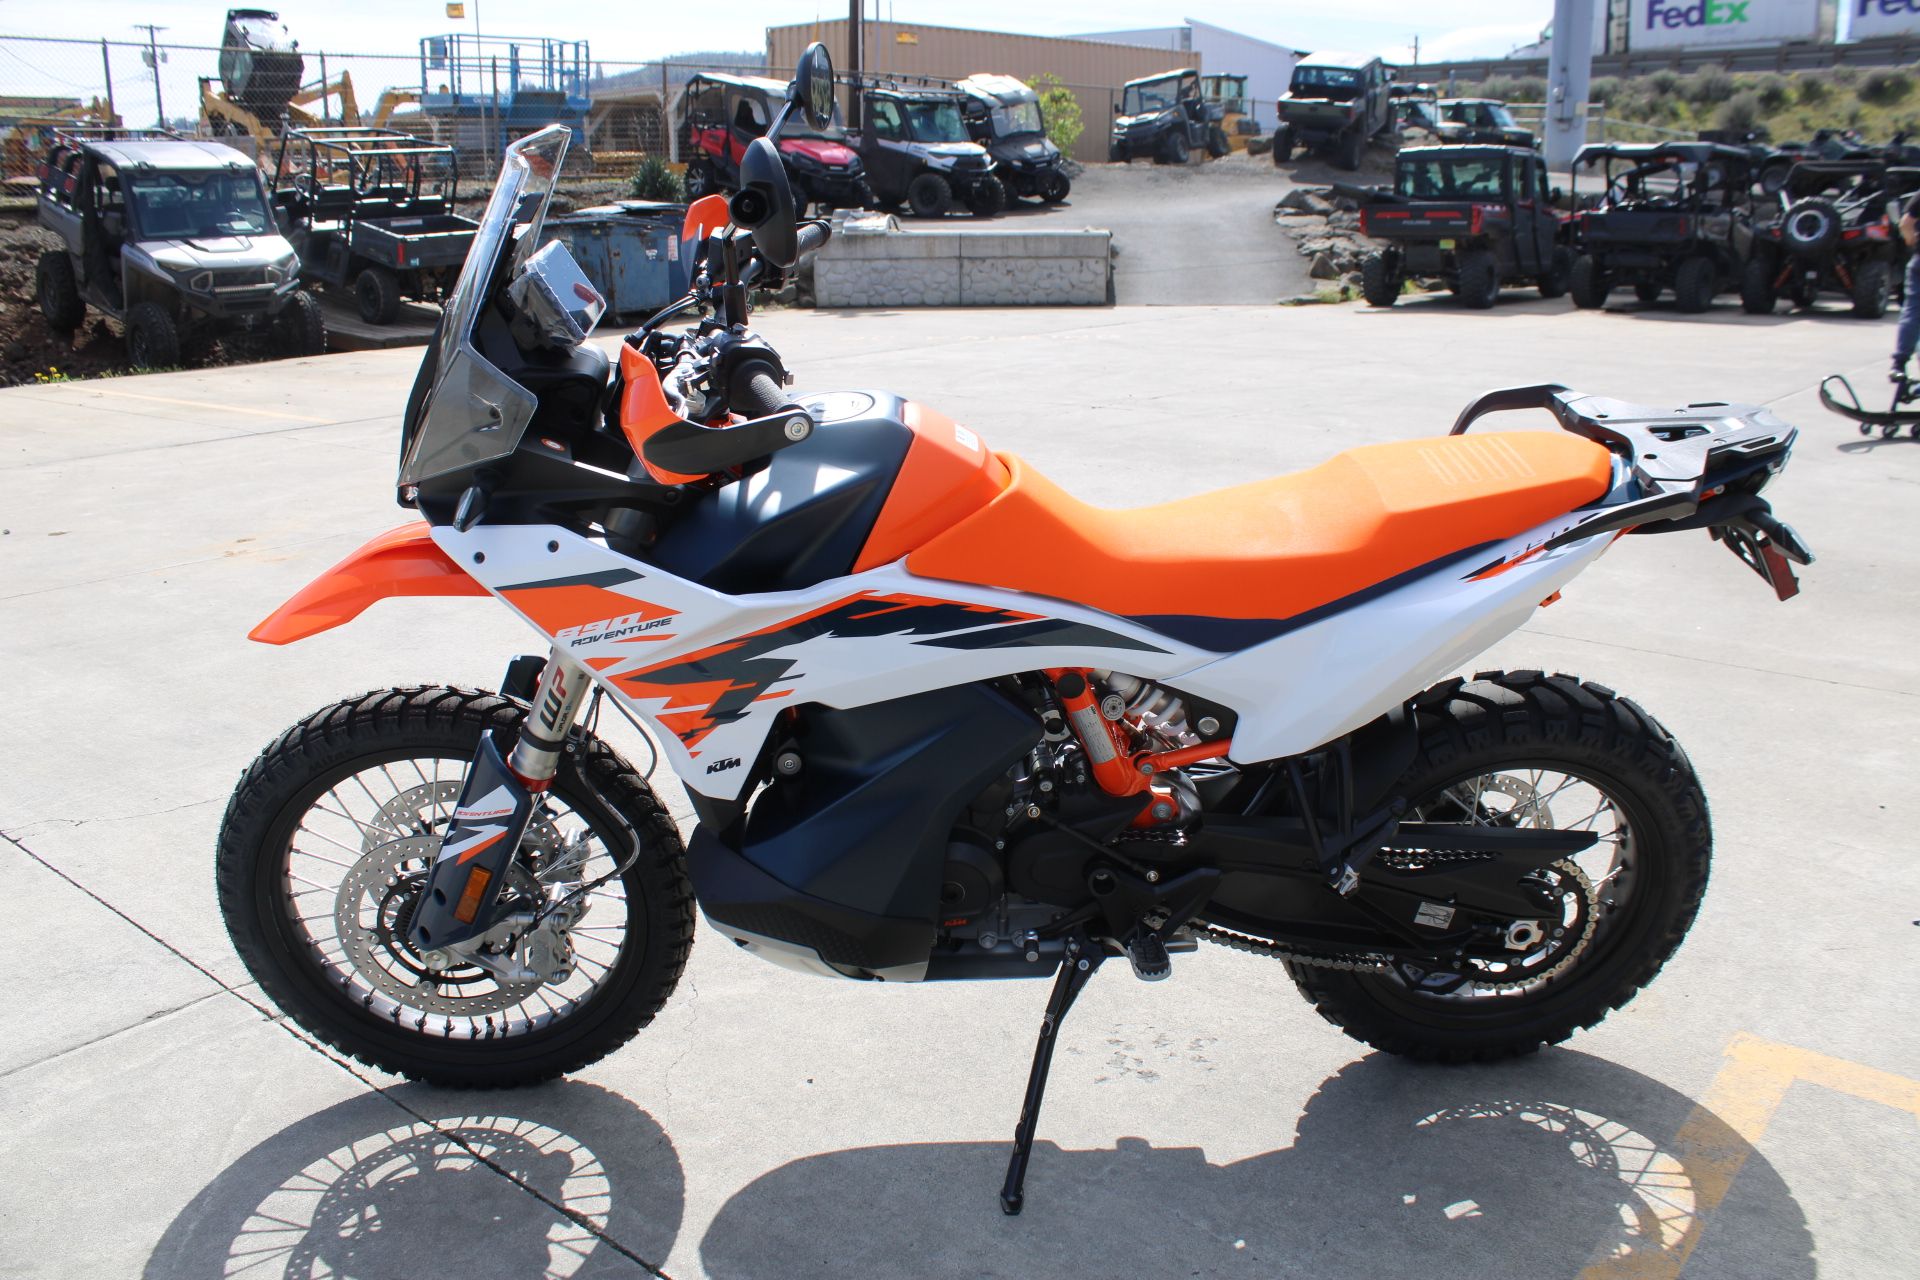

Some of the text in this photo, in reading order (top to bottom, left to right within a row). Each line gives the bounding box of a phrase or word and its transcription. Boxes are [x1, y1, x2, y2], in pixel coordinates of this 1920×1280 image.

[1646, 0, 1748, 30] FedEx
[555, 611, 644, 638] 890
[570, 617, 673, 648] ADVENTURE
[540, 665, 567, 732] WP
[706, 757, 741, 775] KTM
